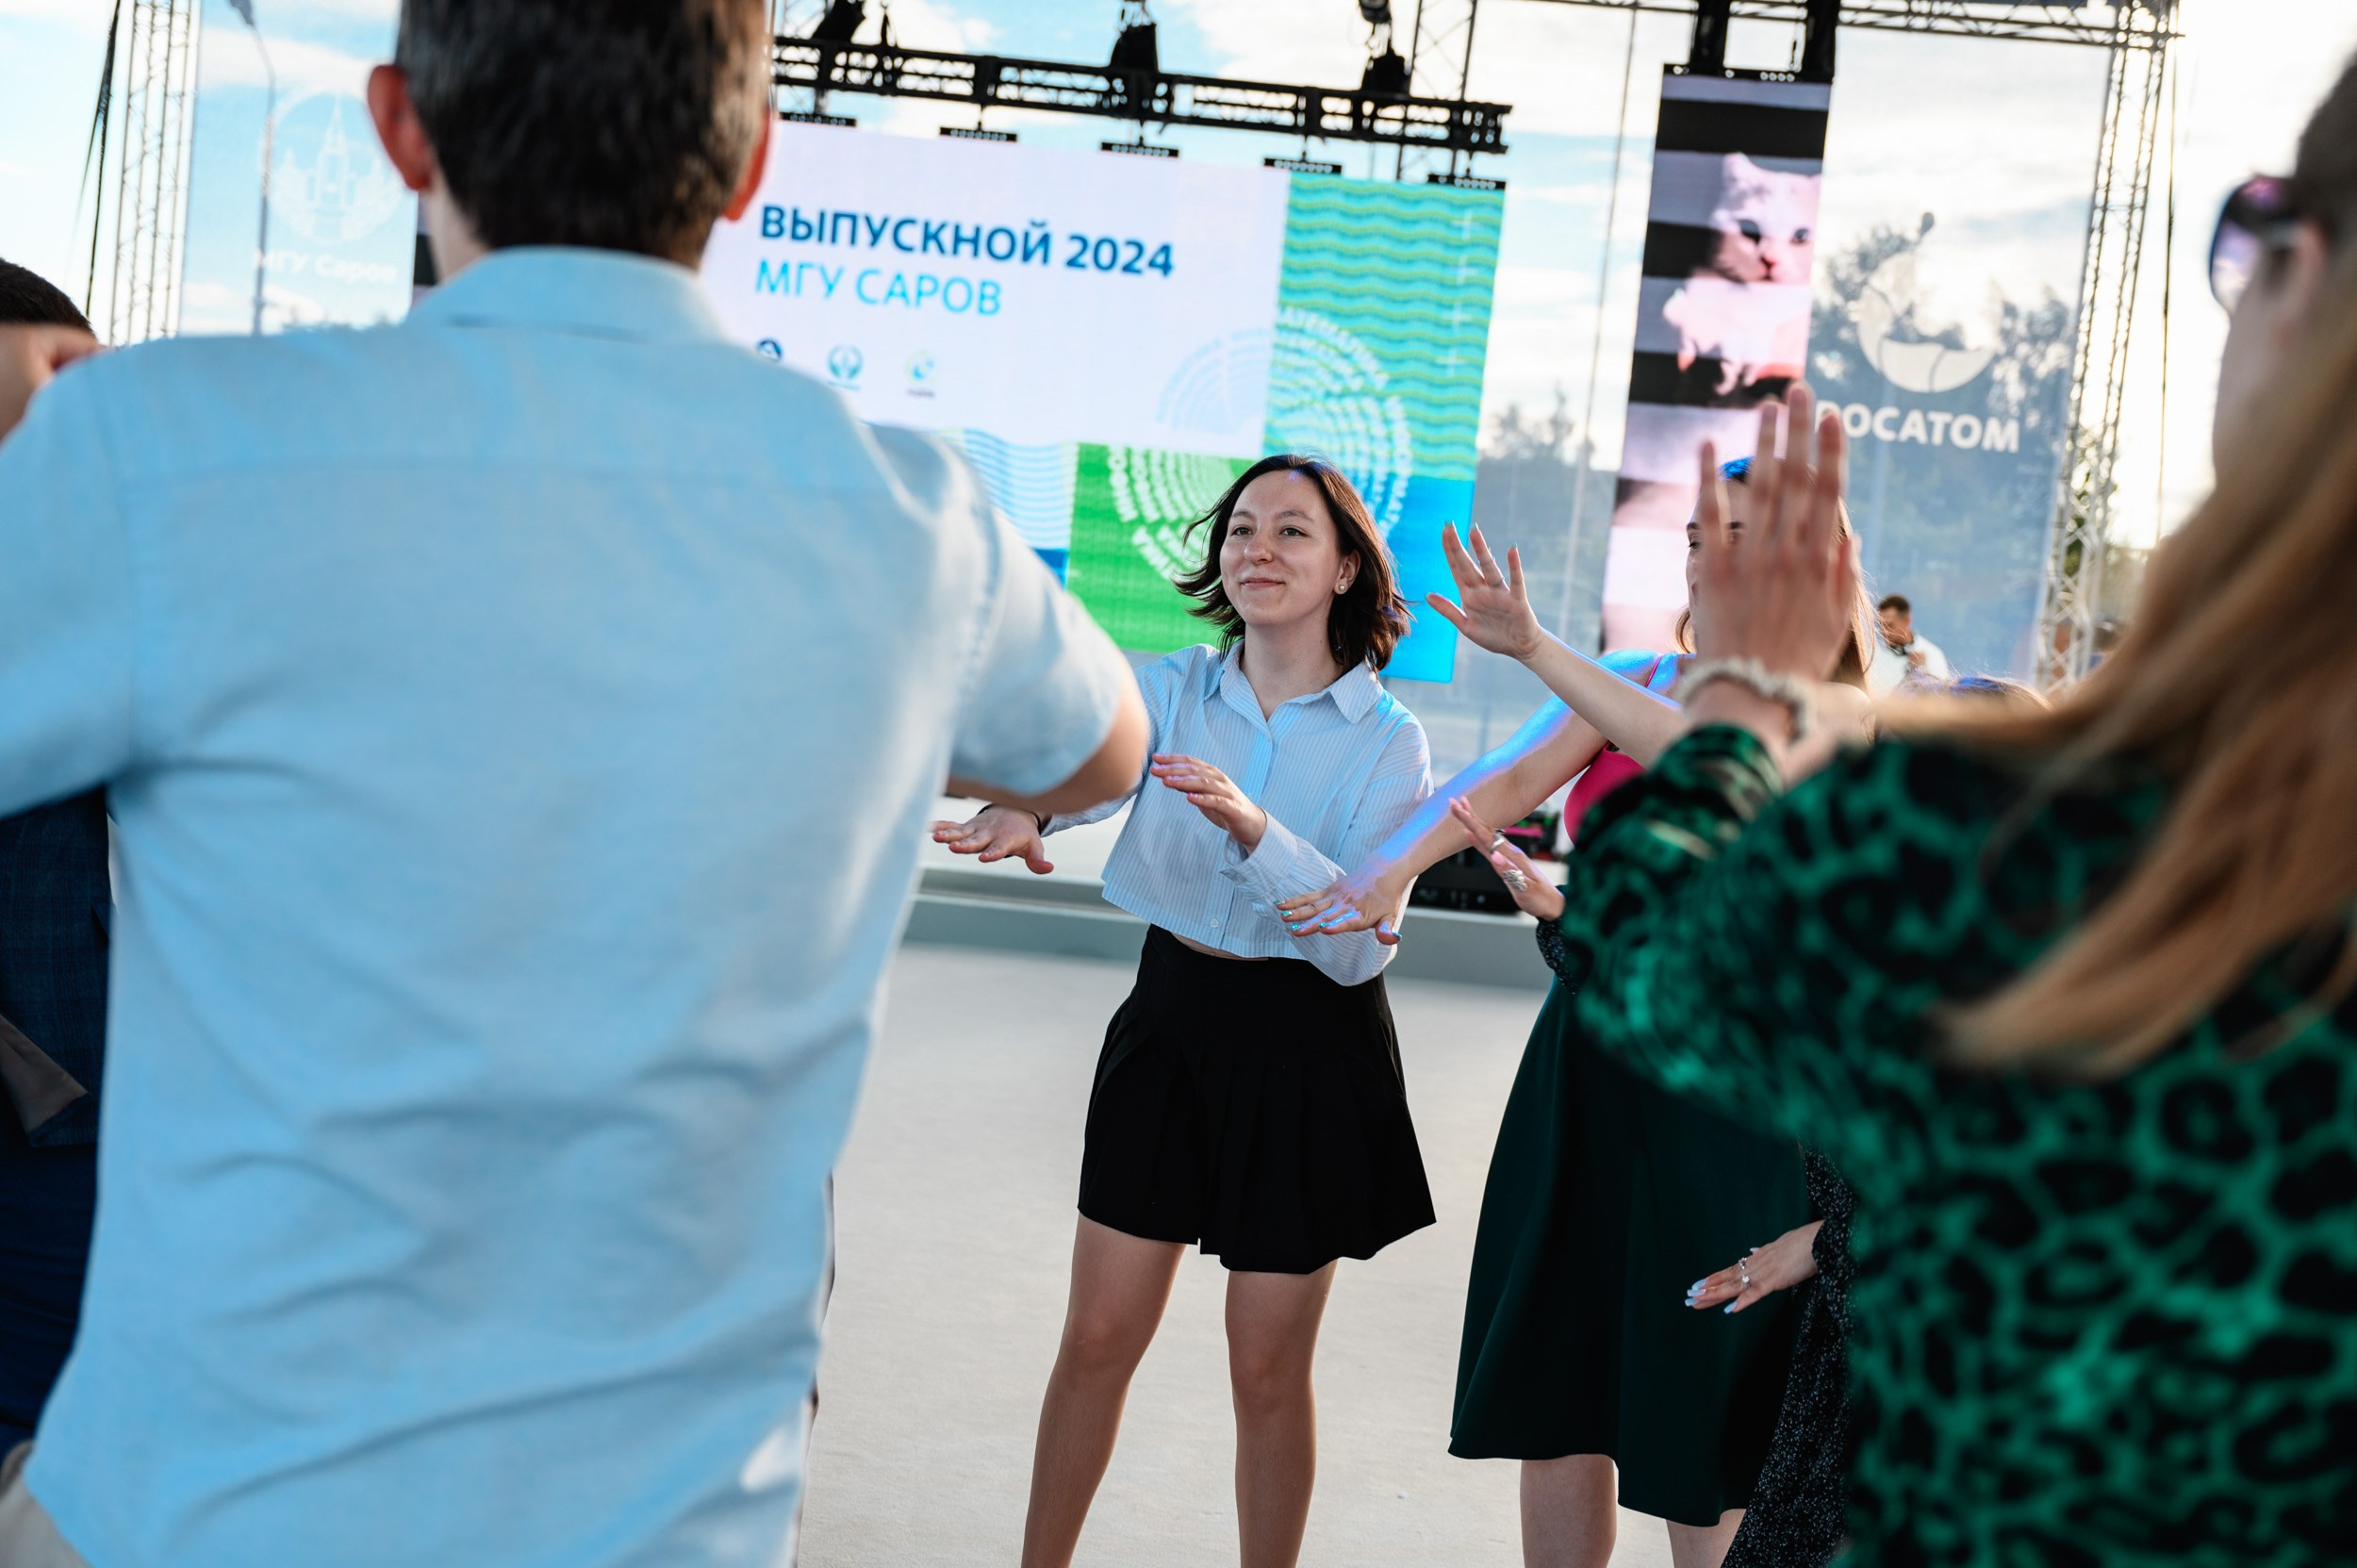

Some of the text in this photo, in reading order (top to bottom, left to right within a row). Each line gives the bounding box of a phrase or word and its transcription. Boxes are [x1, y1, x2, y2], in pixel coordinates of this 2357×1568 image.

[253, 249, 308, 273] МГУ
[761, 205, 1174, 277] ВЫПУСКНОЙ 2024
[755, 258, 1001, 316] МГУ САРОВ
